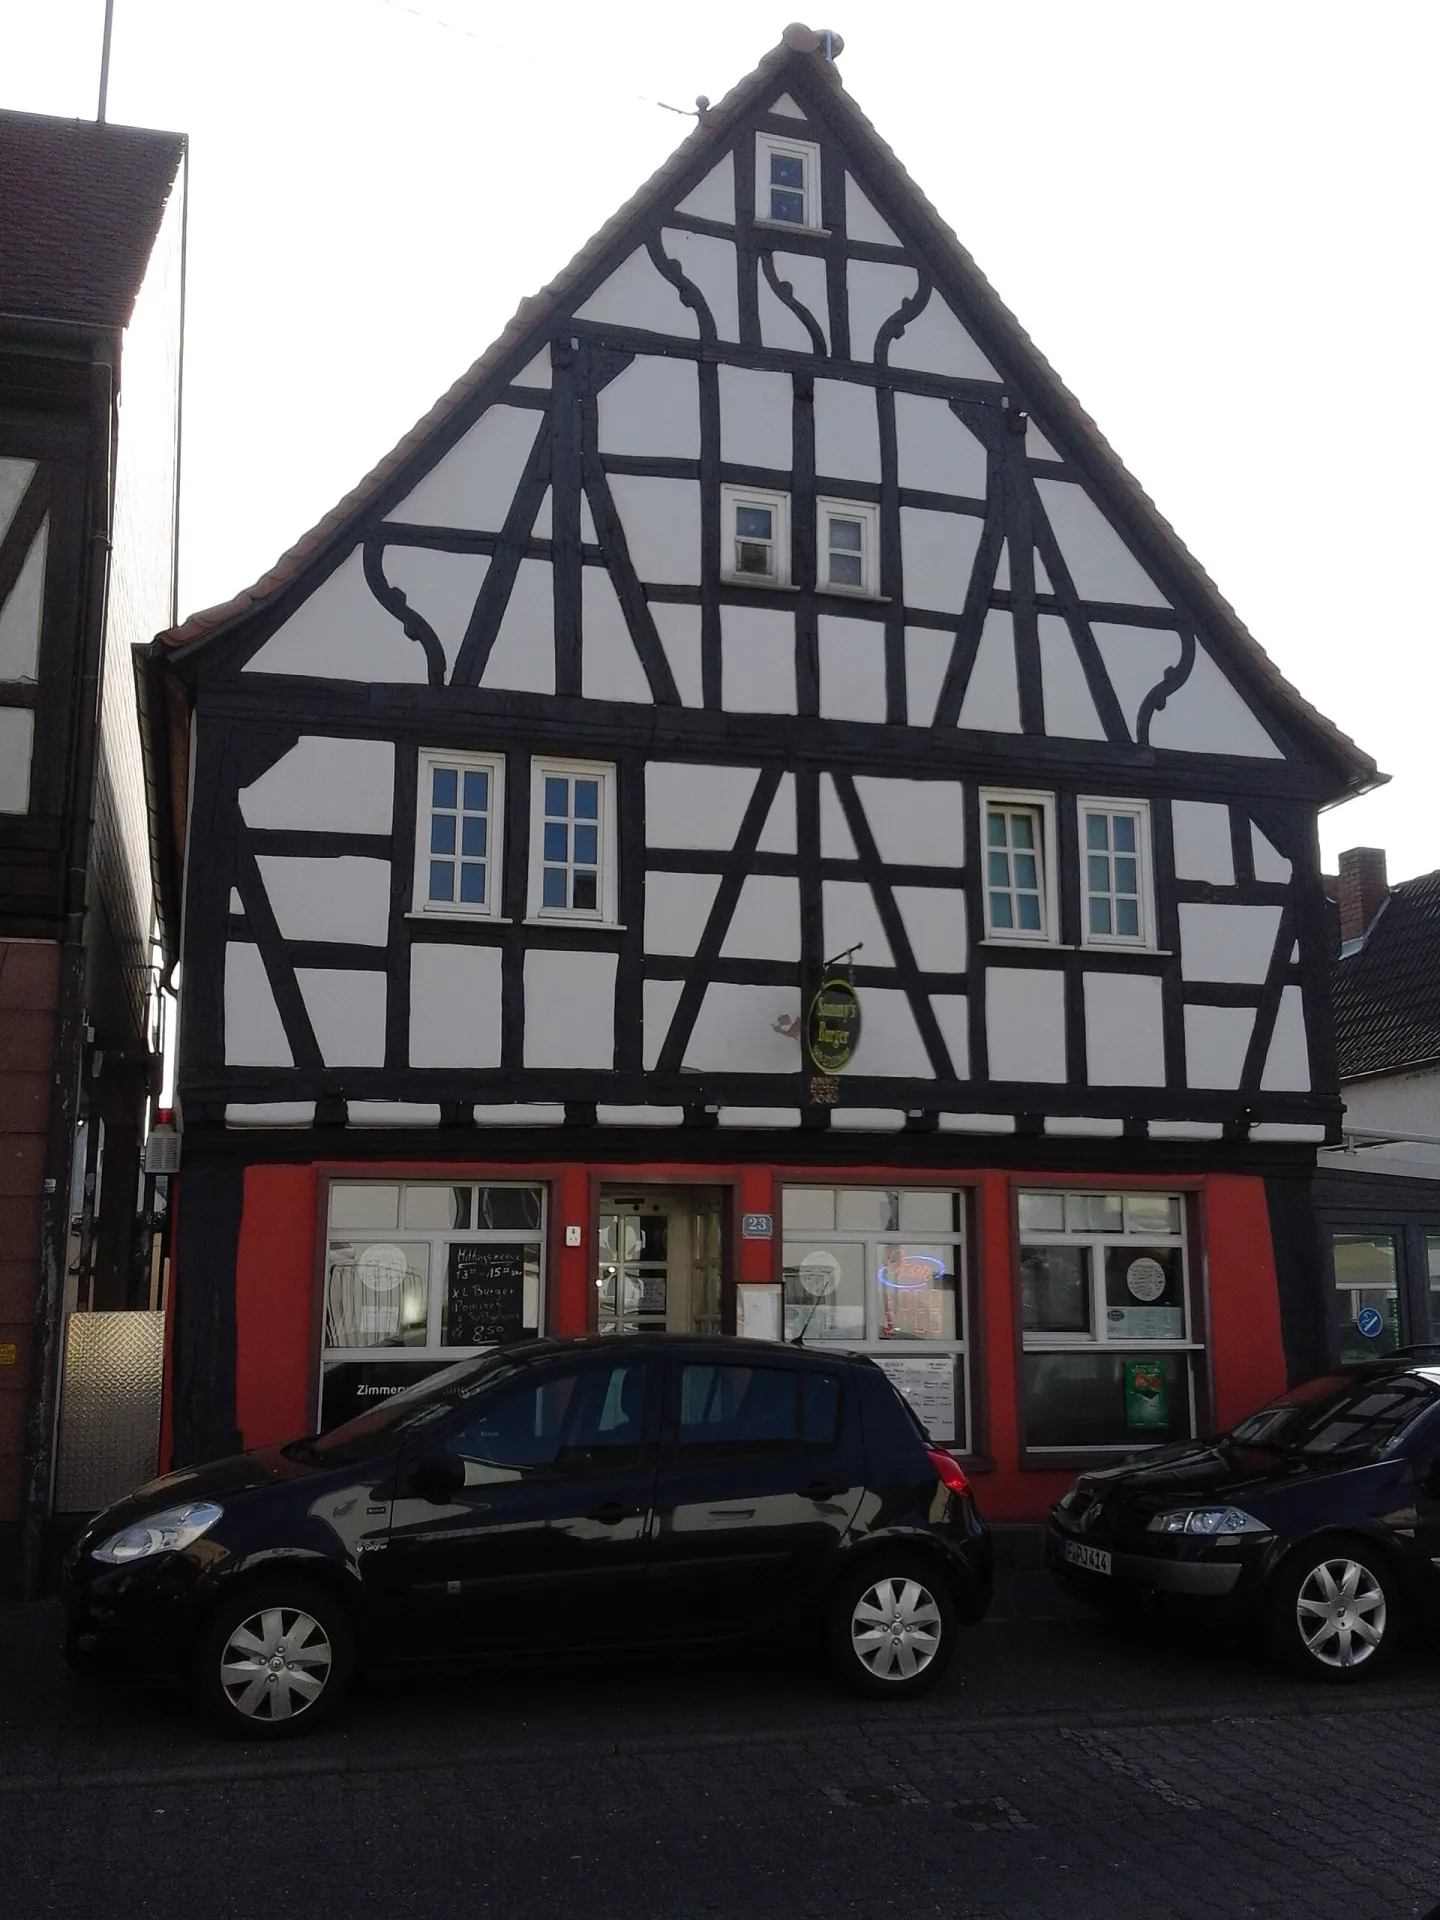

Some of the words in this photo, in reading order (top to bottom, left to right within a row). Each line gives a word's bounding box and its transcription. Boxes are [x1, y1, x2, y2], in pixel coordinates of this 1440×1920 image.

[818, 996, 856, 1023] Sammy's
[817, 1021, 850, 1049] Burger
[749, 1217, 767, 1231] 23
[886, 1246, 933, 1282] Open
[471, 1284, 516, 1302] Burger
